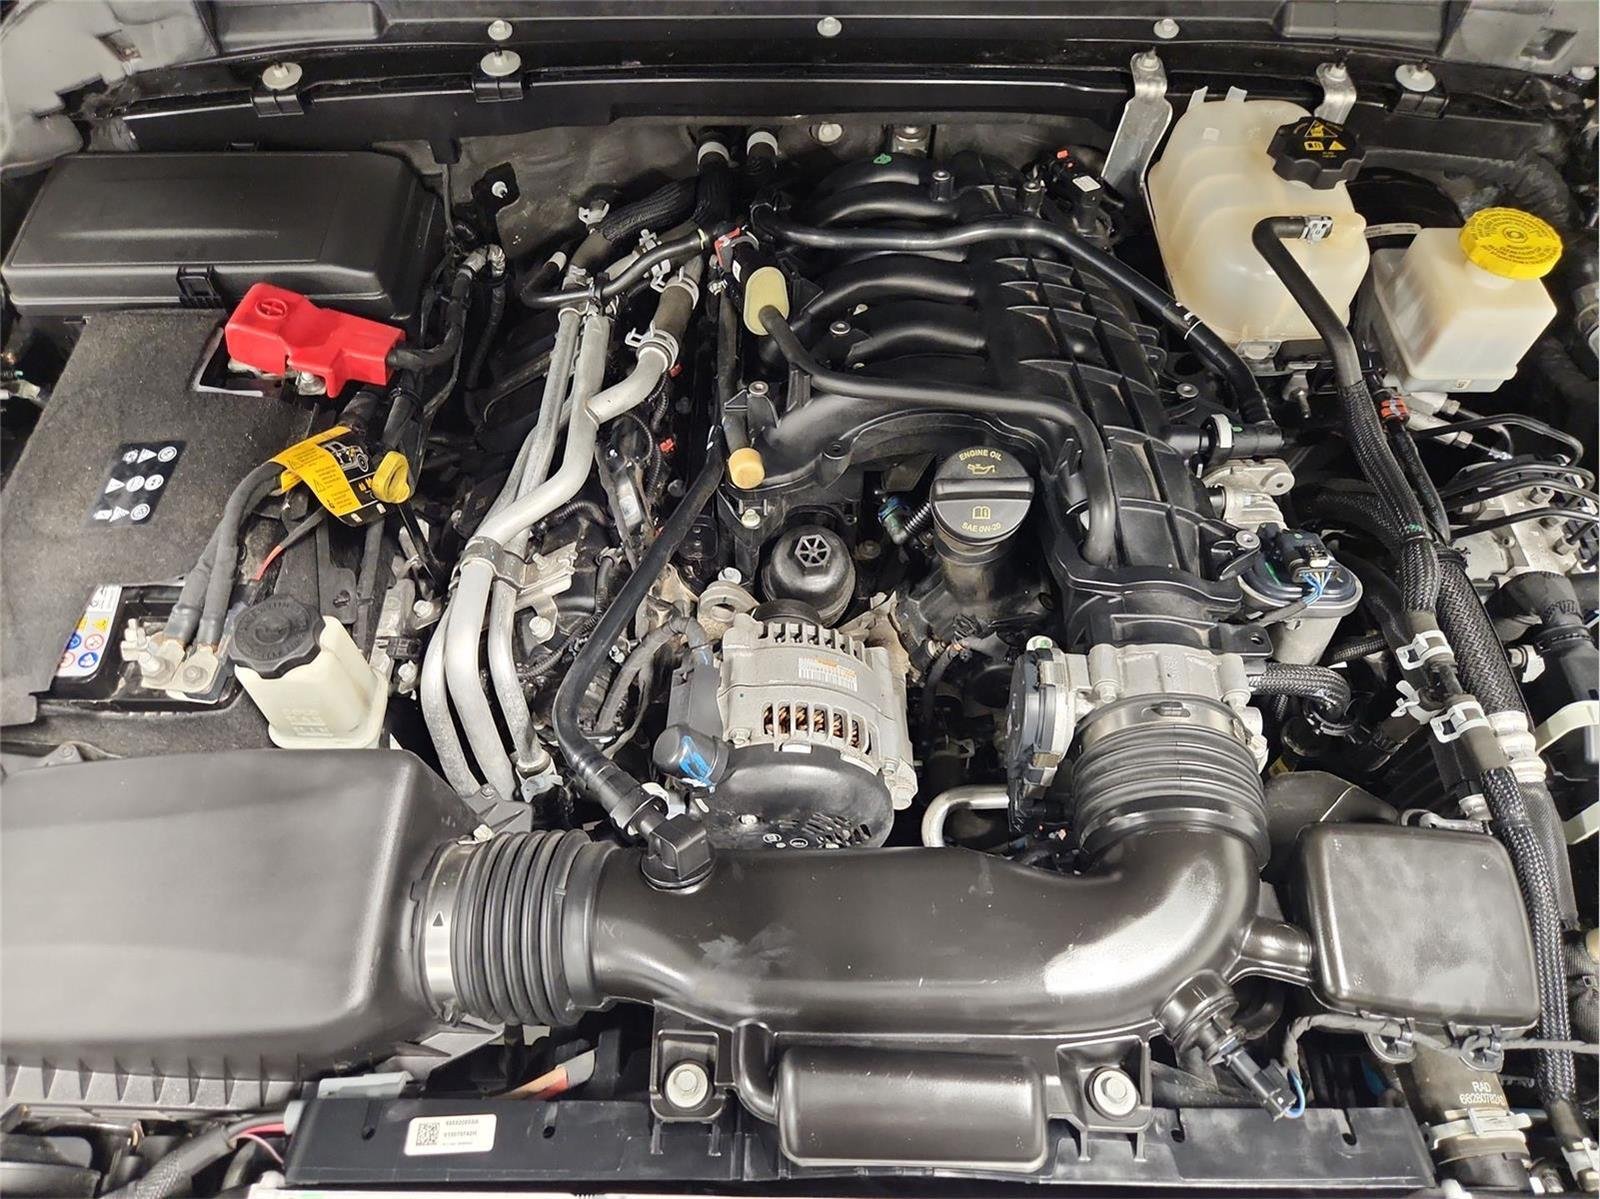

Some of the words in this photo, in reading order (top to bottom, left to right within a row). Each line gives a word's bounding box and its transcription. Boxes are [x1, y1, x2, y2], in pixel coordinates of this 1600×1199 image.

[959, 449, 988, 461] ENGINE
[990, 451, 1002, 461] OIL
[961, 522, 978, 532] SAE
[1472, 1081, 1491, 1092] RAD
